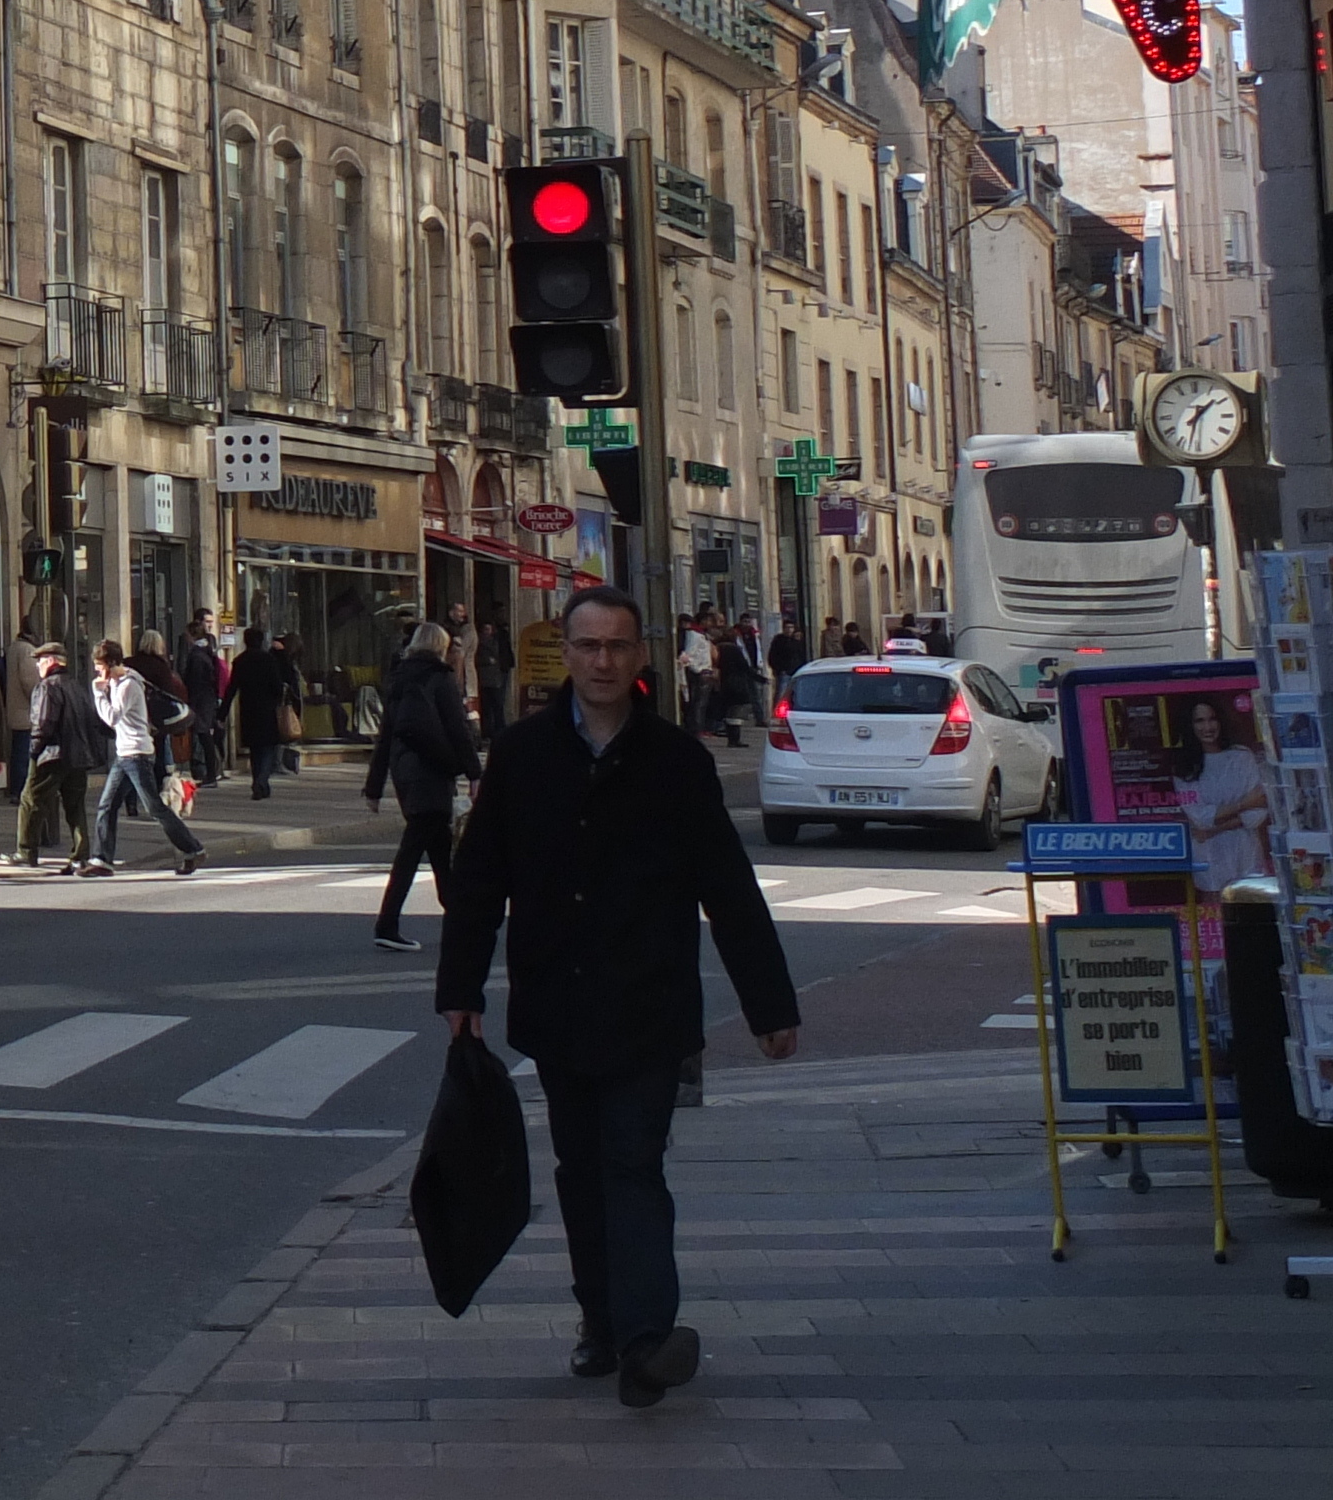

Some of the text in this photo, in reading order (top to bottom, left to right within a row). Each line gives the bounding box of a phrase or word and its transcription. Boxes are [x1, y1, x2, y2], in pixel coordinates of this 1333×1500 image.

[226, 471, 270, 483] SIX
[525, 506, 569, 522] Brioche
[1036, 832, 1178, 851] LE BIEN PUBLIC
[1061, 956, 1169, 979] L'immobilier
[1060, 987, 1176, 1011] d'entreprise
[1084, 1019, 1160, 1043] se porte
[1105, 1051, 1143, 1072] bien
